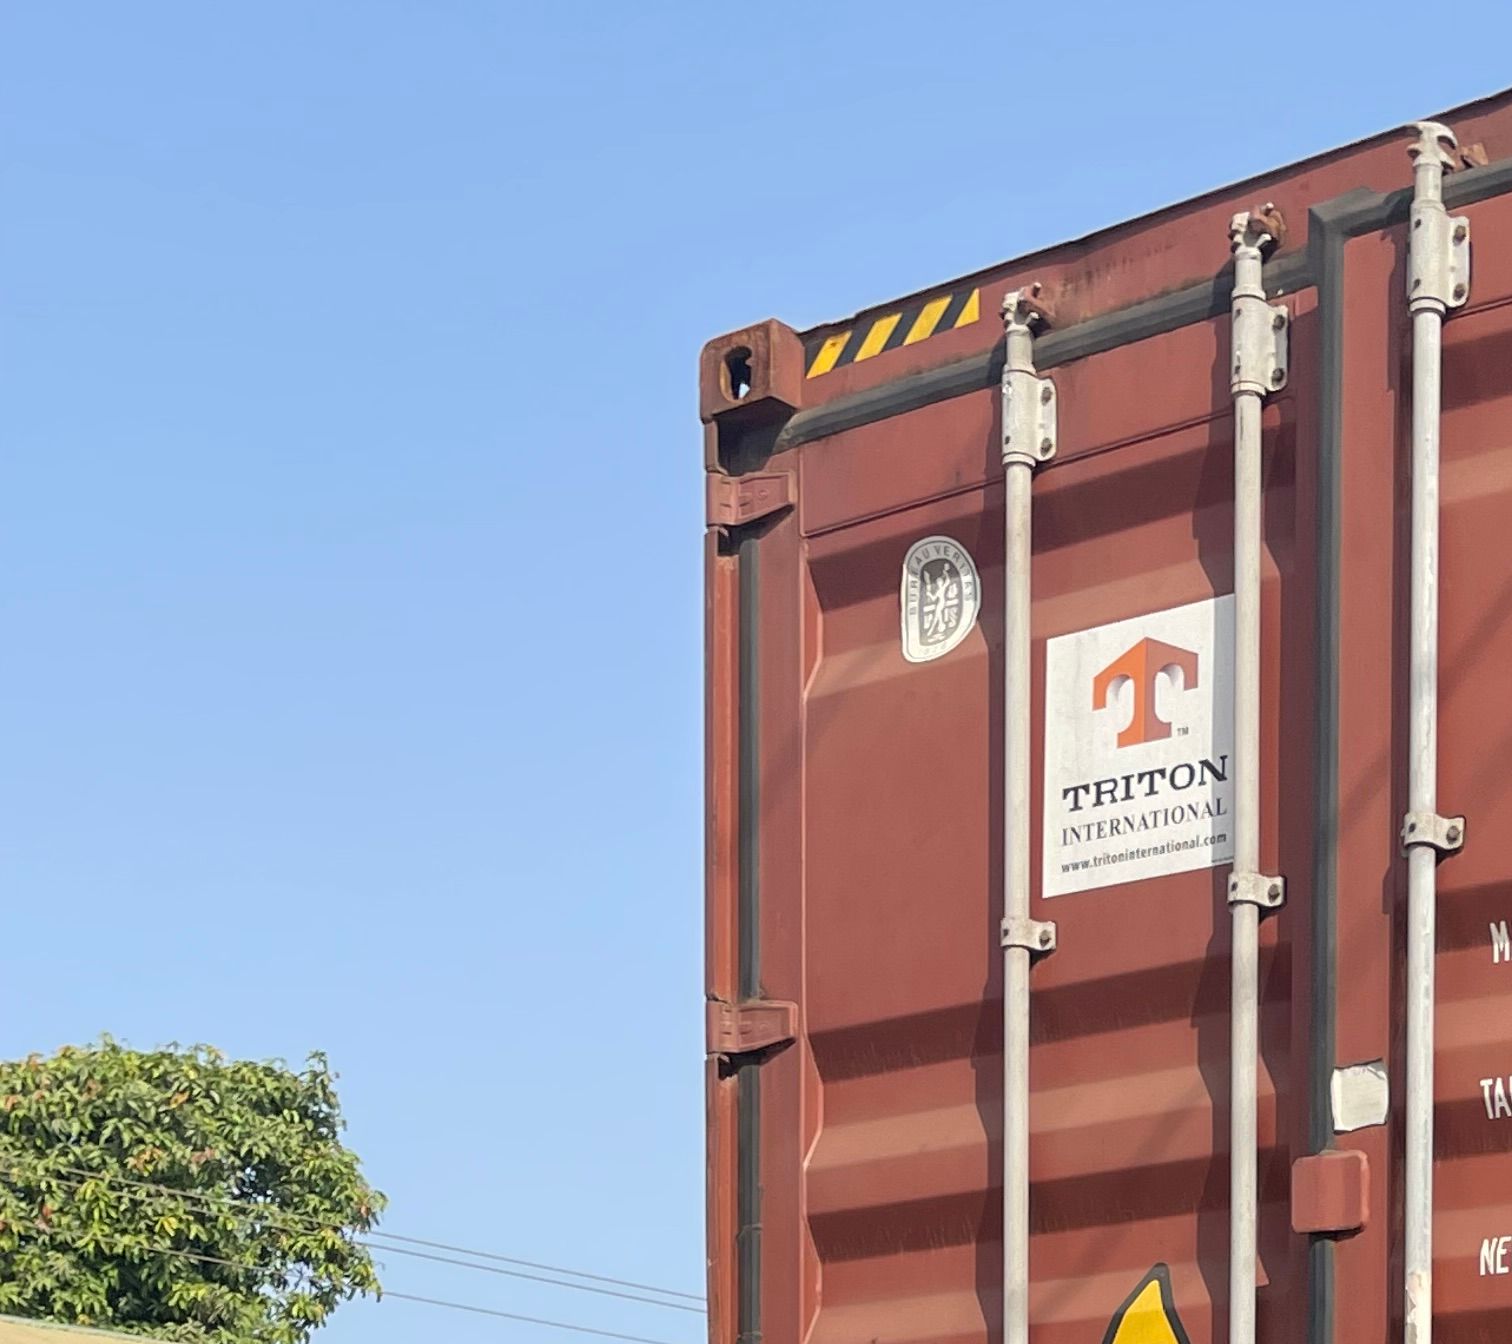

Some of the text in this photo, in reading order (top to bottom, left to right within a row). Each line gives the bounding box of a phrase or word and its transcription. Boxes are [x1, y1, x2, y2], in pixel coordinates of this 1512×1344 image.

[1062, 754, 1229, 813] TRITON
[1061, 797, 1228, 848] INTERNATIONAL
[1060, 832, 1228, 874] www.tritoninternational.com
